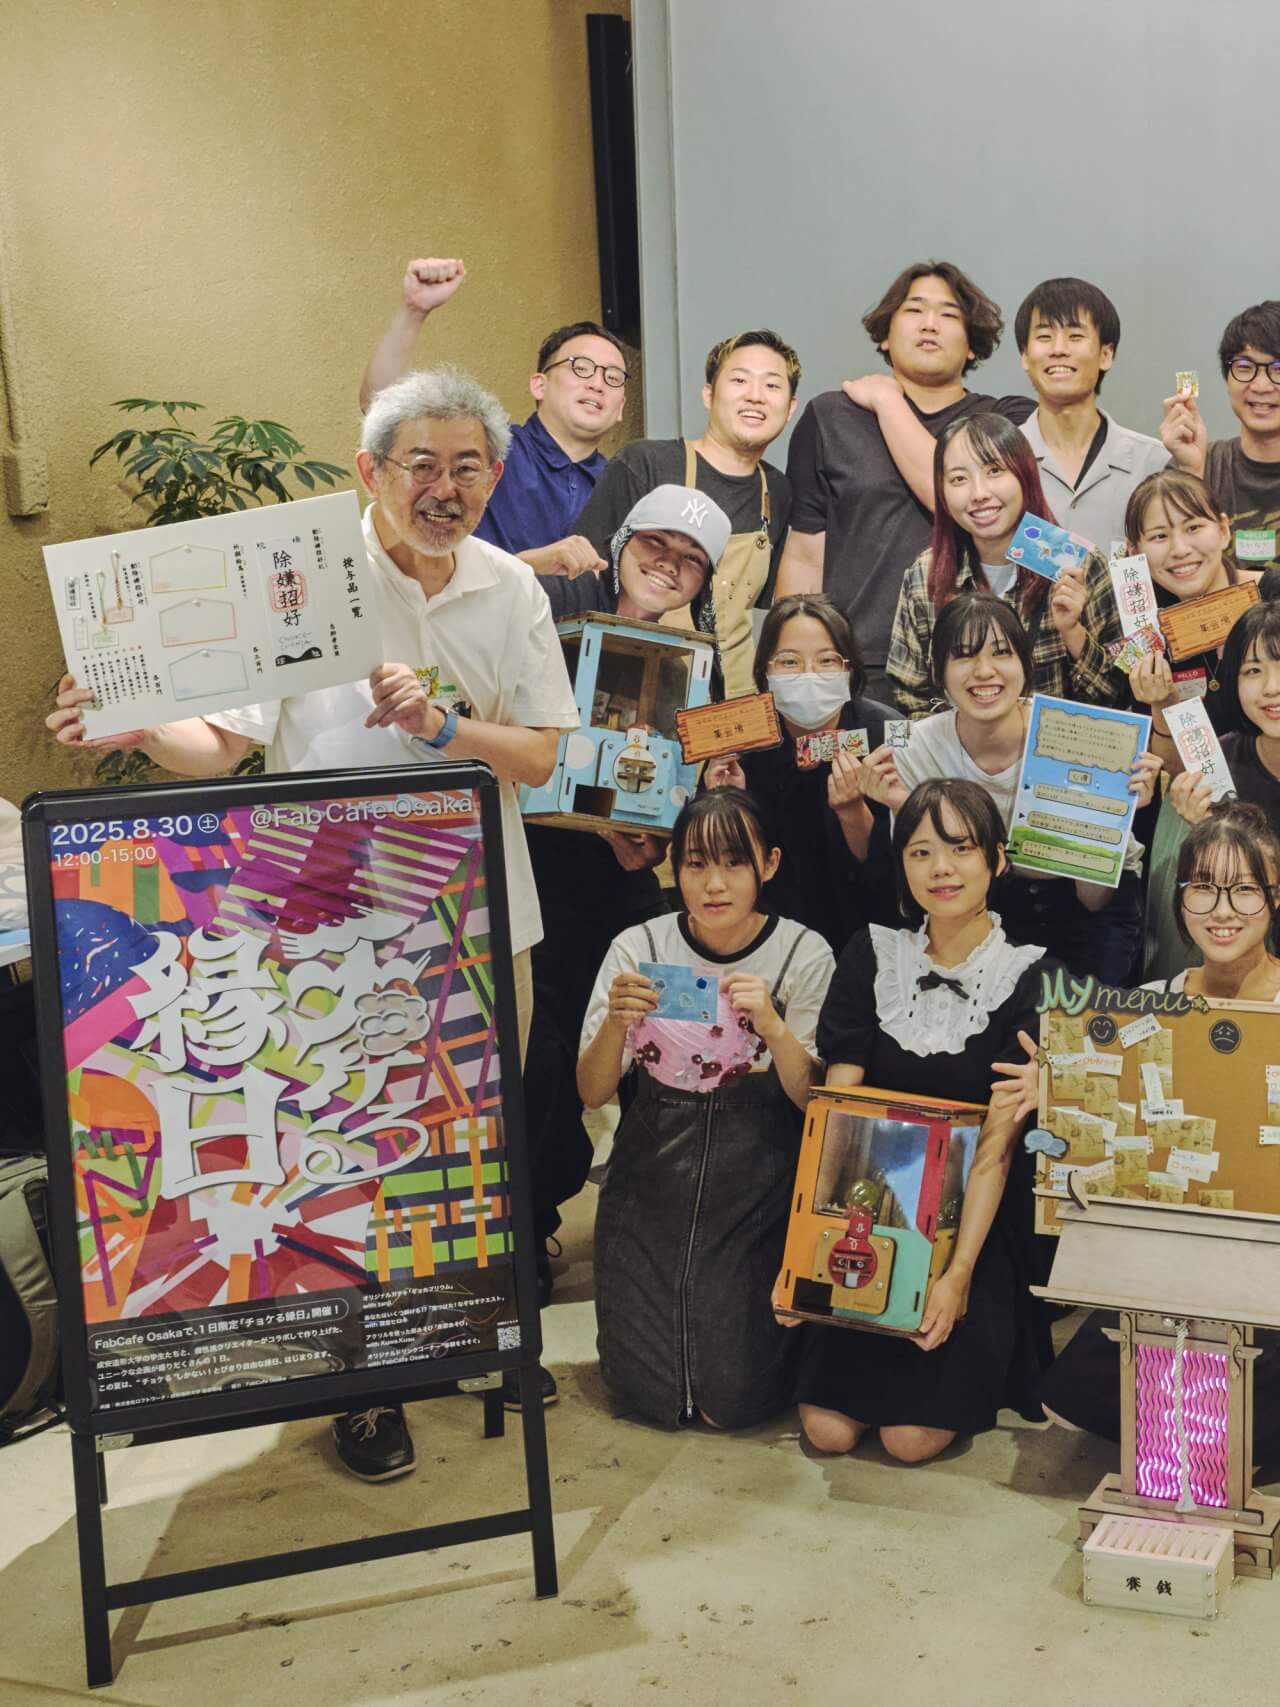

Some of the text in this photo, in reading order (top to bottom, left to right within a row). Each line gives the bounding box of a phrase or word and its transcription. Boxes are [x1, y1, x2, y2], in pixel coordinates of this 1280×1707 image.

[680, 498, 708, 528] NY
[272, 550, 302, 628] 除嫌招好
[250, 797, 472, 829] @FabCafe Osaka
[53, 815, 193, 846] 2025.8.30
[55, 847, 156, 868] 12:00-15:00
[1035, 967, 1190, 1016] My menu
[95, 1335, 144, 1350] FabCafe
